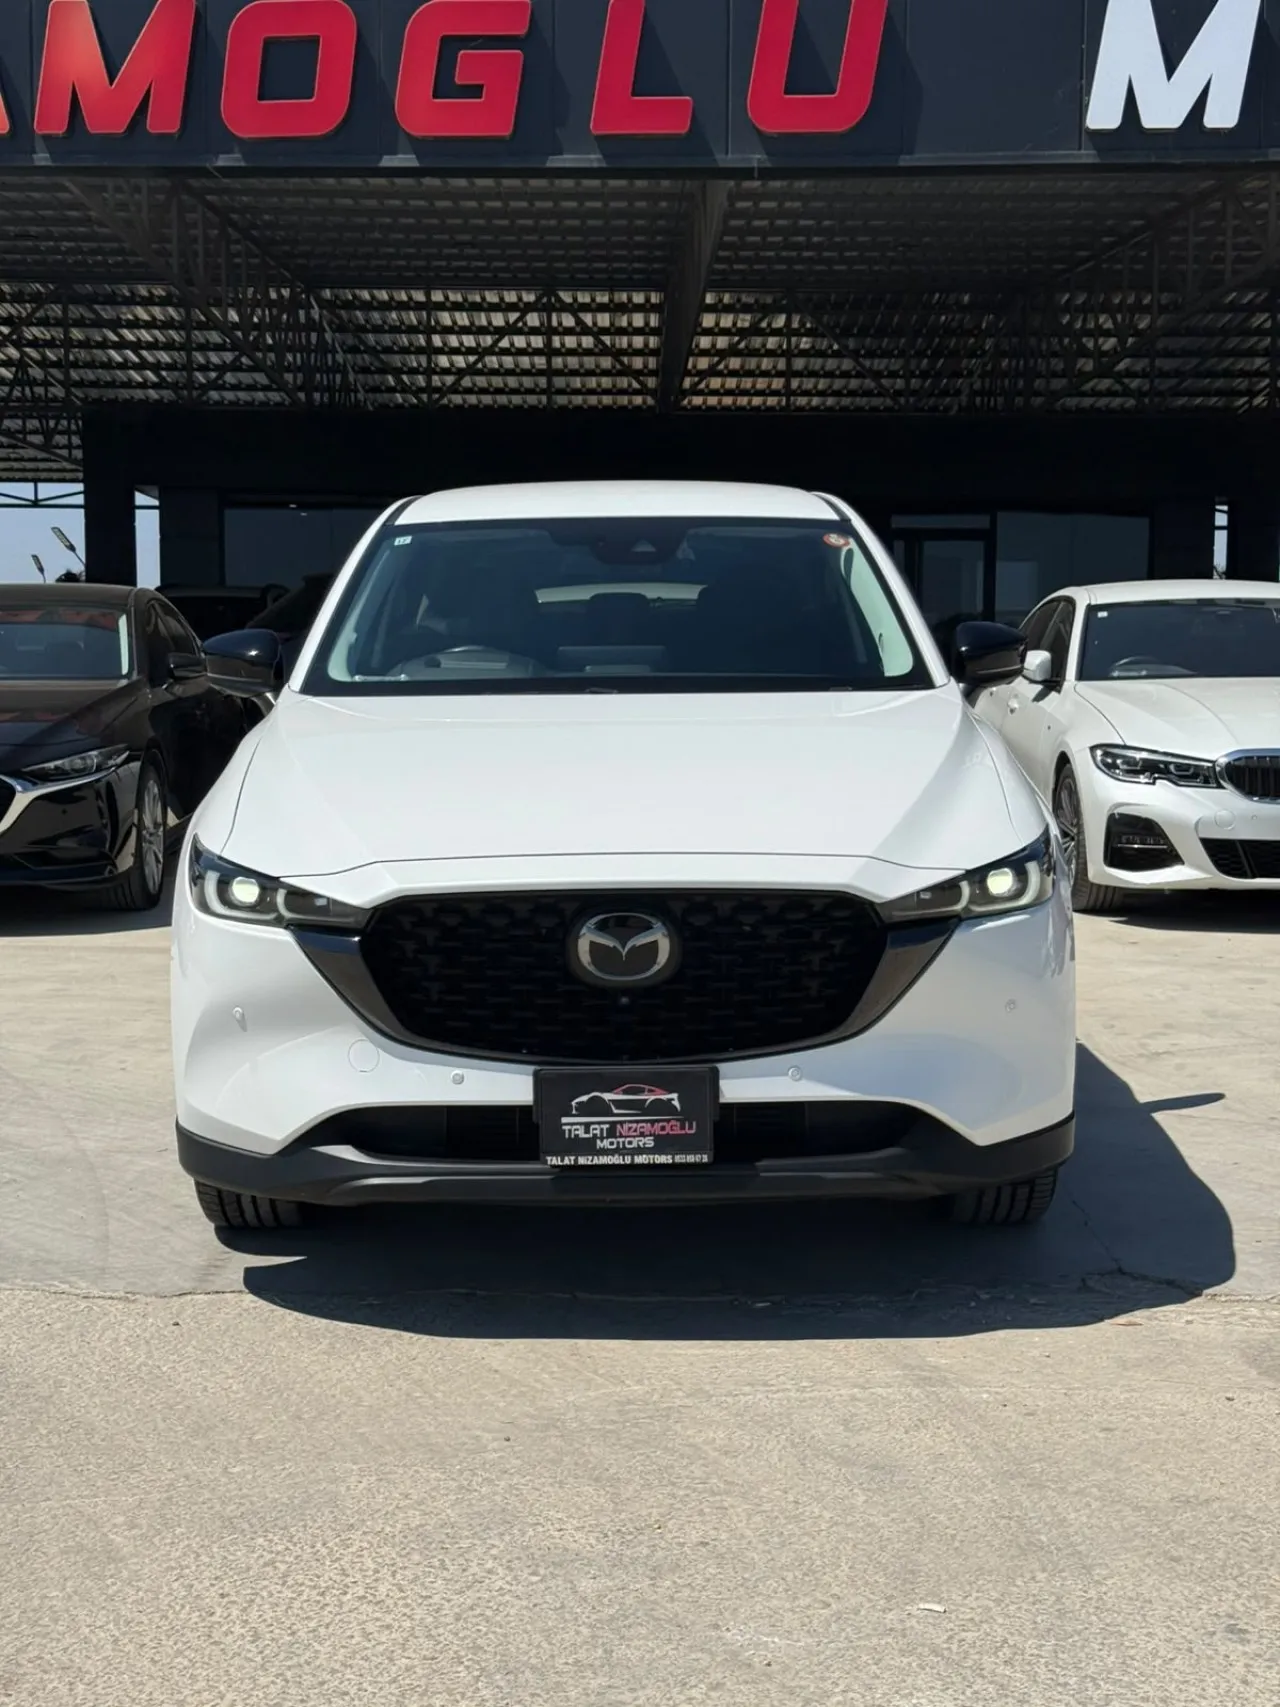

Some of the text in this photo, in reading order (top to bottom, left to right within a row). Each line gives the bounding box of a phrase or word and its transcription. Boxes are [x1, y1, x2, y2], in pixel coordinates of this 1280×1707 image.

[0, 0, 1262, 138] MOGLU M
[562, 1124, 610, 1138] TALAT
[596, 1136, 654, 1149] MOTORS
[546, 1156, 575, 1166] TALAT
[634, 1155, 673, 1164] MOTORS
